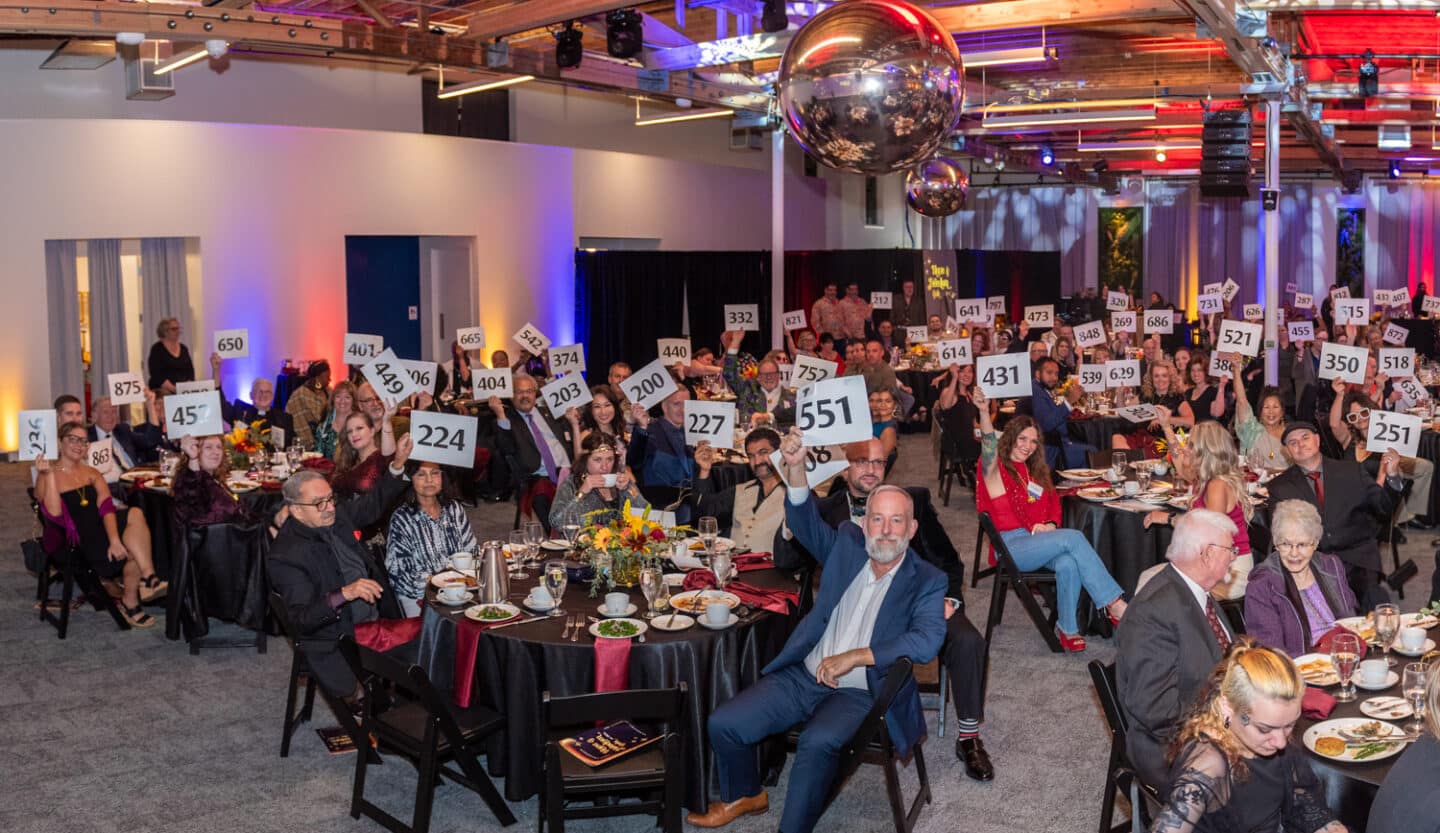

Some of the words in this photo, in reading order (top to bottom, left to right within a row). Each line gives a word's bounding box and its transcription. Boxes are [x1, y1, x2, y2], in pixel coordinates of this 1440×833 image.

[960, 305, 980, 317] 641
[1200, 299, 1218, 309] 731
[729, 311, 753, 324] 332
[1028, 311, 1049, 321] 473
[1246, 308, 1260, 316] 626
[1114, 317, 1132, 327] 269
[1147, 316, 1168, 327] 686
[460, 333, 481, 344] 665
[519, 327, 543, 350] 542
[1079, 327, 1100, 342] 848
[1223, 329, 1251, 346] 521
[1291, 326, 1310, 336] 455
[1387, 329, 1404, 340] 872
[218, 337, 243, 351] 650
[553, 351, 579, 367] 374
[663, 346, 687, 358] 440
[942, 346, 966, 360] 614
[1325, 353, 1359, 373] 350
[1384, 356, 1409, 369] 518
[374, 361, 404, 395] 449
[798, 364, 828, 382] 752
[982, 365, 1019, 386] 431
[1082, 371, 1102, 384] 539
[115, 380, 141, 396] 875
[478, 376, 506, 390] 404
[630, 372, 664, 402] 200
[549, 382, 581, 408] 203
[1401, 382, 1421, 401] 635
[799, 396, 852, 431] 551
[689, 413, 725, 435] 227
[417, 424, 465, 451] 224
[1374, 422, 1410, 445] 251
[92, 448, 109, 466] 863
[805, 446, 833, 473] 08
